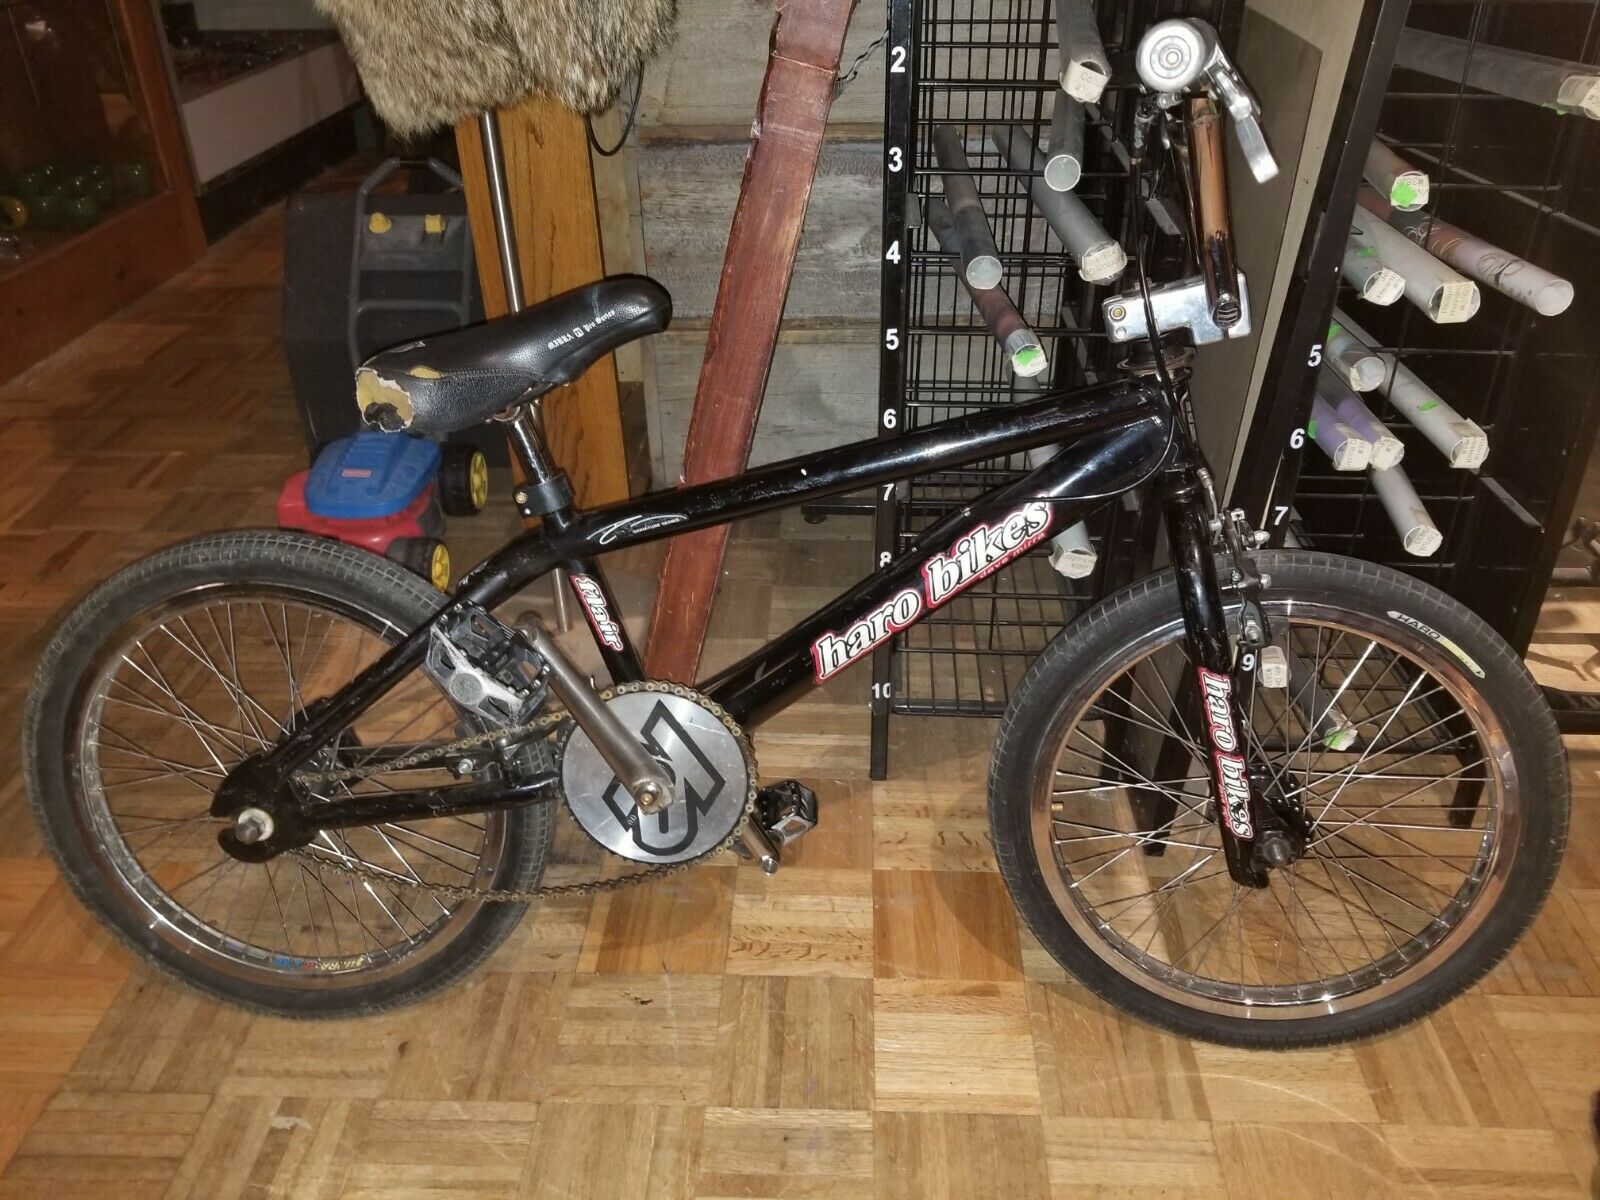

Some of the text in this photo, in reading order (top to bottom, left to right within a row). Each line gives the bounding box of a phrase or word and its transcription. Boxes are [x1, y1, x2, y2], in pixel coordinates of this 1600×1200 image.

[890, 45, 906, 73] 2
[888, 146, 903, 172] 3
[885, 240, 901, 264] 4
[886, 328, 899, 350] 5
[1307, 344, 1322, 367] 5
[883, 408, 897, 429] 6
[1290, 428, 1306, 449] 6
[882, 483, 895, 501] 7
[1273, 506, 1289, 526] 7
[880, 551, 892, 569] 8
[817, 496, 1050, 680] haro bikes
[574, 577, 622, 650] flair
[1397, 614, 1441, 639] HARO
[1241, 653, 1255, 672] 9
[872, 682, 891, 699] 10
[1201, 673, 1237, 751] haro
